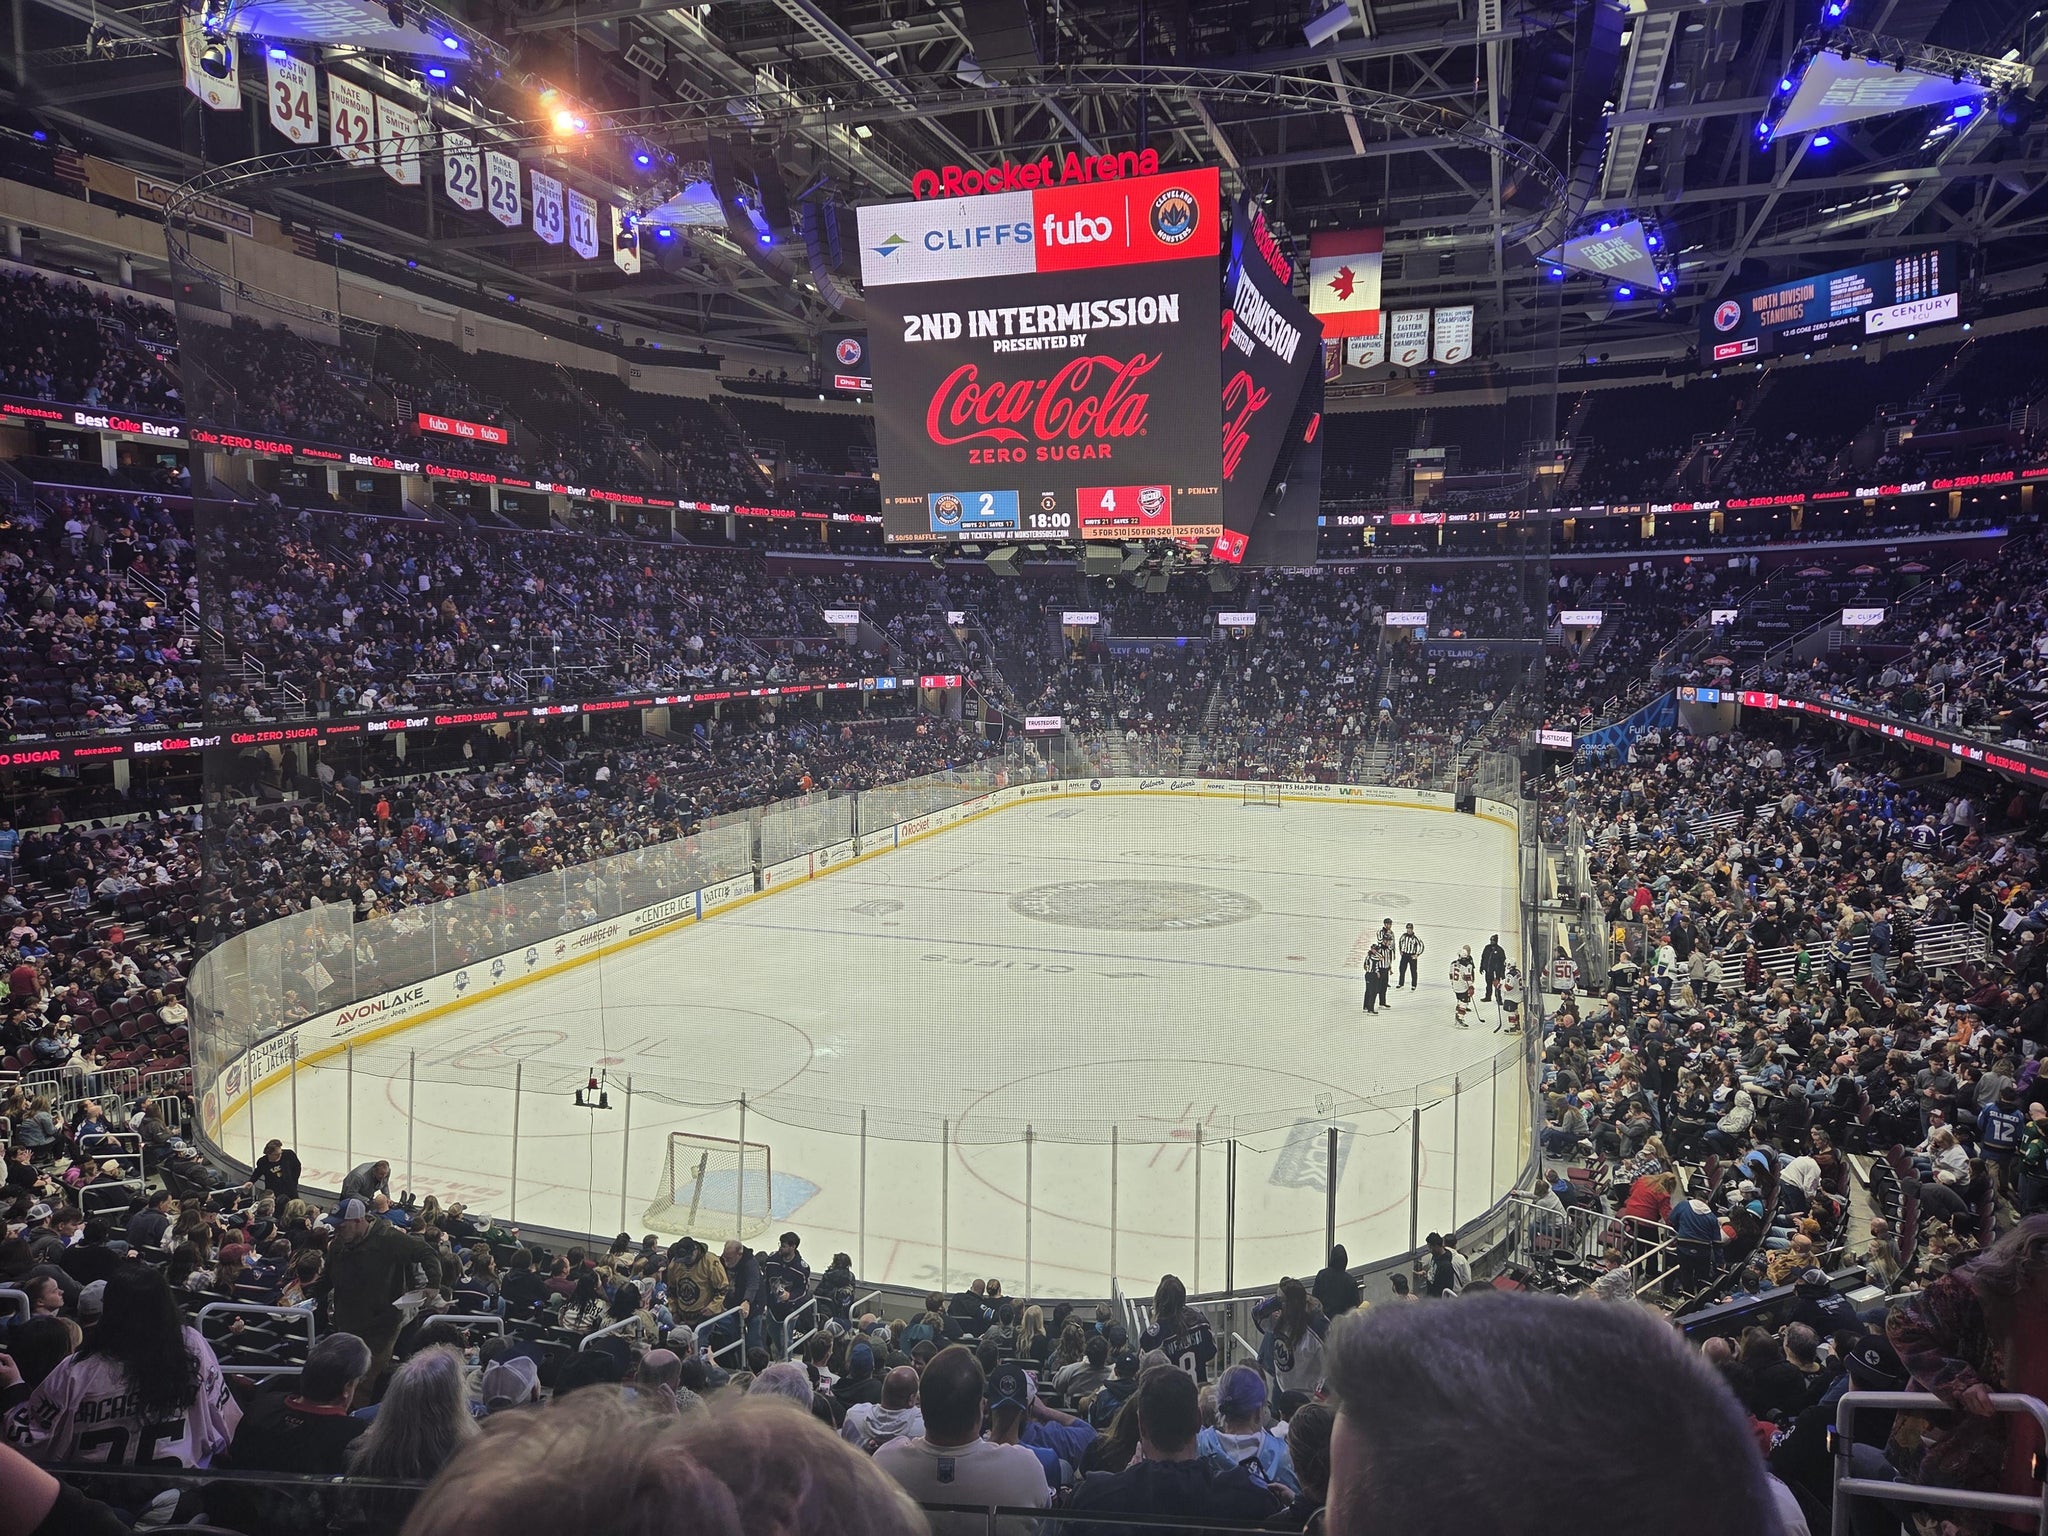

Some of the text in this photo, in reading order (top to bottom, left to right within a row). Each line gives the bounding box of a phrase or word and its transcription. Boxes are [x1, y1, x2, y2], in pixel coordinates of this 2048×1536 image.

[279, 69, 304, 86] CARR
[340, 85, 361, 101] NATE
[274, 80, 314, 129] 34
[331, 91, 371, 115] THURMOND
[335, 108, 370, 154] 42
[385, 116, 411, 133] SMITH
[391, 132, 406, 166] 7
[493, 155, 512, 170] MARK
[450, 157, 478, 198] 22
[493, 165, 513, 179] PRICE
[942, 148, 1159, 197] Rocket Arena
[491, 176, 518, 214] 25
[1155, 188, 1193, 208] CLEVELAND
[536, 197, 560, 233] 43
[574, 214, 593, 247] 11
[924, 222, 1033, 251] CLIFFS
[1043, 212, 1112, 246] fubo
[1157, 226, 1192, 243] MONSTERS
[1580, 236, 1630, 257] FEAR THE
[1588, 244, 1643, 270] DEPTHS
[1752, 285, 1814, 312] NORTH DIVISION
[1760, 304, 1803, 326] STANDINGS
[1892, 298, 1952, 317] CENTURY
[903, 293, 1180, 342] 2ND INTERMISSION
[1397, 314, 1424, 323] 2017-18
[1437, 315, 1471, 324] CHAMPIONS
[1912, 312, 1930, 321] FCU
[1392, 330, 1427, 339] CONFERENCE
[1813, 333, 1828, 341] BEST
[993, 333, 1087, 353] PRESENTED BY
[1351, 341, 1381, 350] CHAMPIONS
[1393, 339, 1425, 347] CHAMPIONS
[1720, 346, 1737, 356] Ohio
[926, 352, 1163, 446] Coca-Cola
[3, 403, 63, 421] #takeataste
[75, 412, 180, 438] Best Coke Ever?
[429, 418, 499, 440] fubo fubo fubo
[190, 429, 293, 455] Coke ZERO SUGAR
[969, 444, 1112, 464] ZERO SUGAR
[350, 453, 420, 472] Best Coke Ever?
[426, 464, 496, 484] Coke ZERO SUGAR
[1932, 479, 1953, 489] Coke
[1954, 476, 1979, 487] ZERO
[1981, 471, 2014, 484] SUGAR
[1187, 487, 1219, 495] PENALTY
[1856, 481, 1927, 497] Best Coke Ever?
[895, 496, 923, 505] PENALTY
[979, 493, 995, 516] 2
[1100, 490, 1116, 512] 4
[1651, 500, 1720, 513] Best Coke Ever?
[1726, 493, 1805, 508] Coke ZERO SUGAR
[1029, 513, 1071, 529] 18:00
[1337, 515, 1365, 525] 18:00
[1408, 514, 1416, 523] 4
[1469, 513, 1480, 521] 21
[1508, 511, 1521, 519] 22
[914, 534, 937, 542] RAFFLE
[959, 532, 970, 540] BUY
[971, 531, 992, 540] TICKETS
[993, 531, 1006, 540] NOW
[1007, 531, 1014, 539] AT
[1099, 529, 1113, 537] FOR
[1114, 528, 1127, 537] $10
[1131, 527, 1172, 537] 50 FOR $20
[1176, 526, 1220, 535] 125 FOR $40
[1757, 621, 1790, 629] Restoration.
[1730, 639, 1764, 647] Construction.
[883, 680, 893, 688] 24
[924, 678, 934, 687] 21
[368, 717, 429, 732] Best Coke Ever?
[435, 716, 452, 725] Coke
[452, 714, 472, 724] ZERO
[473, 711, 498, 721] SUGAR
[73, 729, 90, 737] LEVEL
[231, 728, 318, 744] Coke ZERO SUGAR
[1629, 726, 1645, 734] Full
[134, 735, 221, 753] Best Coke Ever?
[13, 750, 60, 765] SUGAR
[1140, 779, 1165, 790] Culver's
[1171, 780, 1195, 791] Culver's
[1294, 784, 1323, 792] HAPPEN
[1339, 788, 1363, 797] WM
[908, 818, 930, 836] Rocket
[1918, 832, 1926, 843] 3
[642, 903, 676, 923] CENTER
[677, 896, 690, 910] ICE
[1555, 965, 1571, 978] 50
[336, 987, 423, 1026] AVONLAKE
[1993, 1120, 2015, 1142] 12
